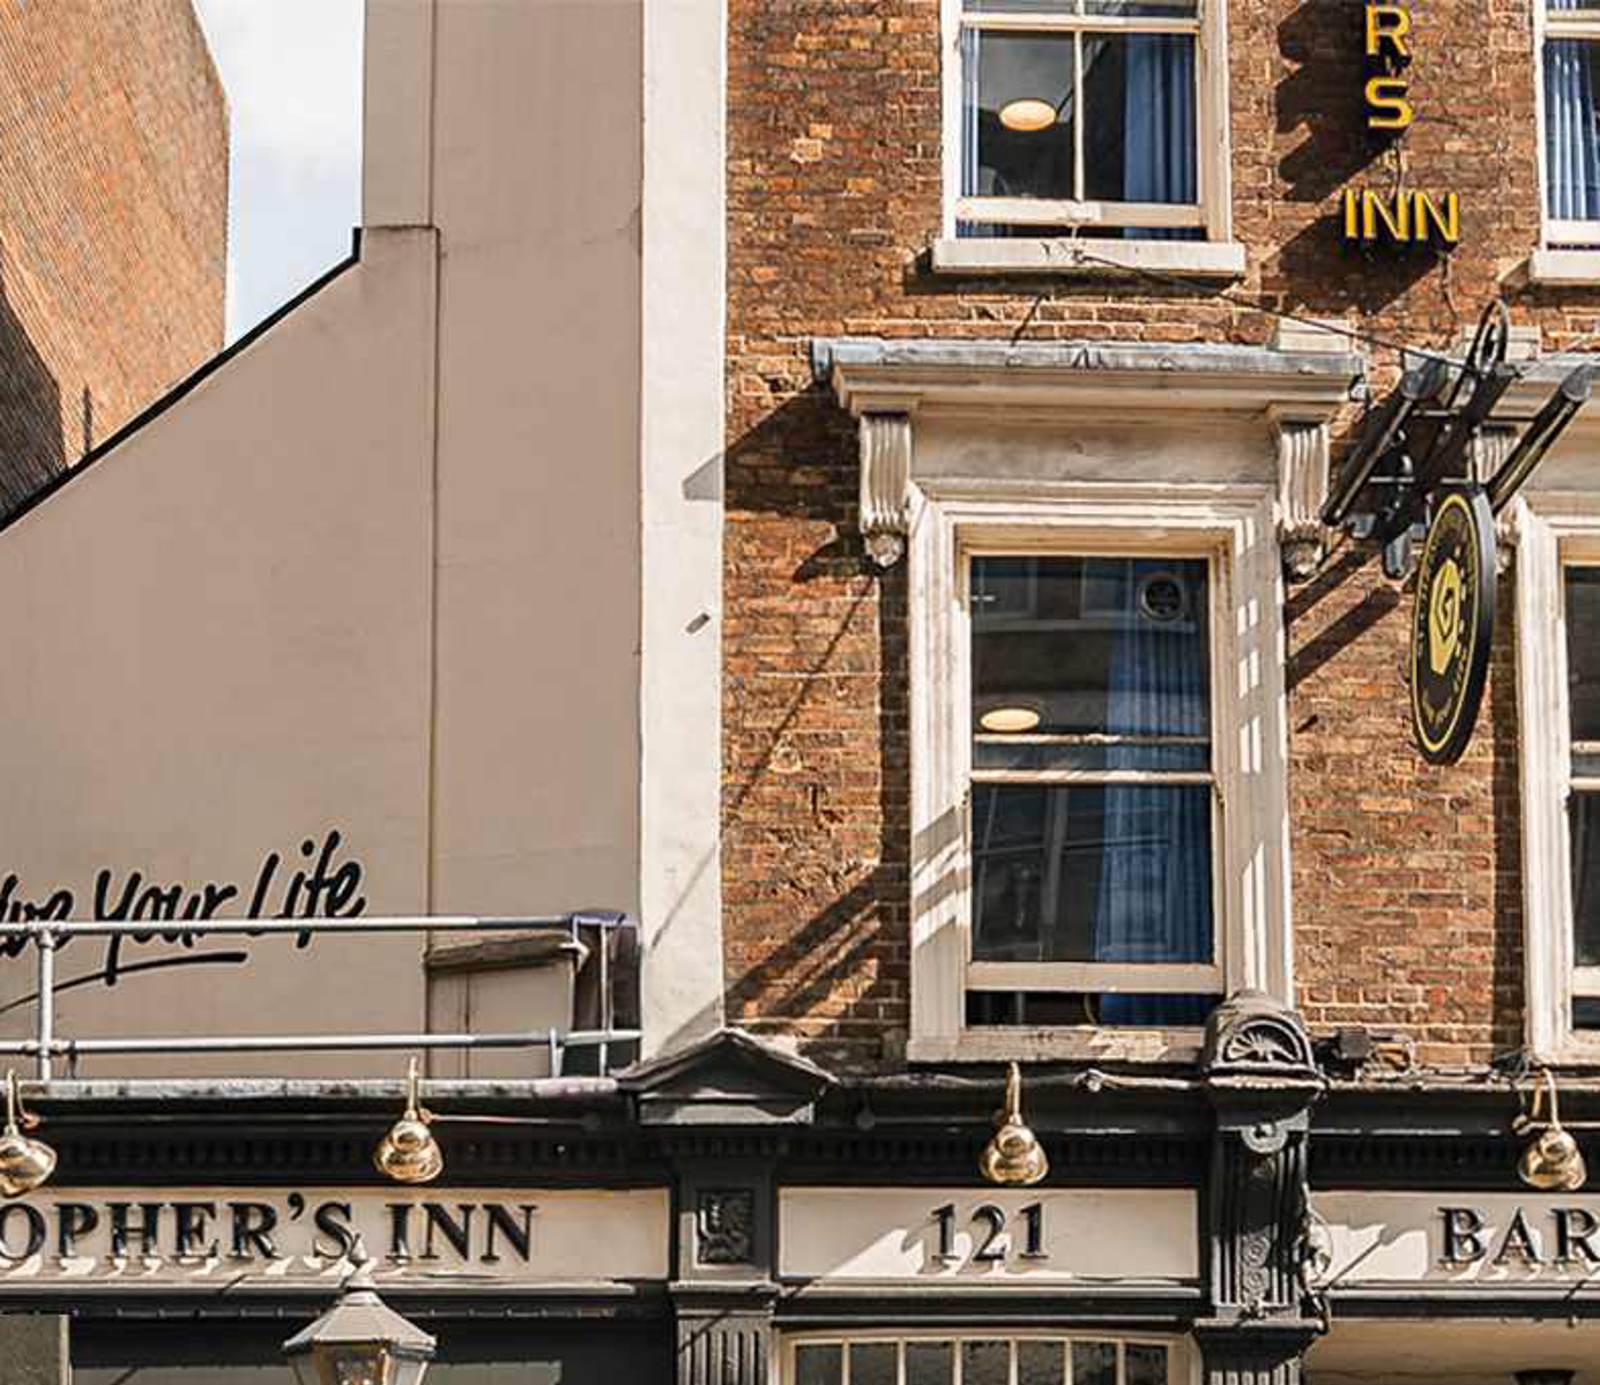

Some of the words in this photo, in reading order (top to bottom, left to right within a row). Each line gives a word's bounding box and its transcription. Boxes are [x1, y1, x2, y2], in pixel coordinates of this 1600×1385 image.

[1344, 188, 1459, 242] INN
[0, 1192, 353, 1261] OPHER'S
[385, 1203, 537, 1262] INN
[931, 1203, 1049, 1261] 121
[1437, 1206, 1600, 1264] BAR
